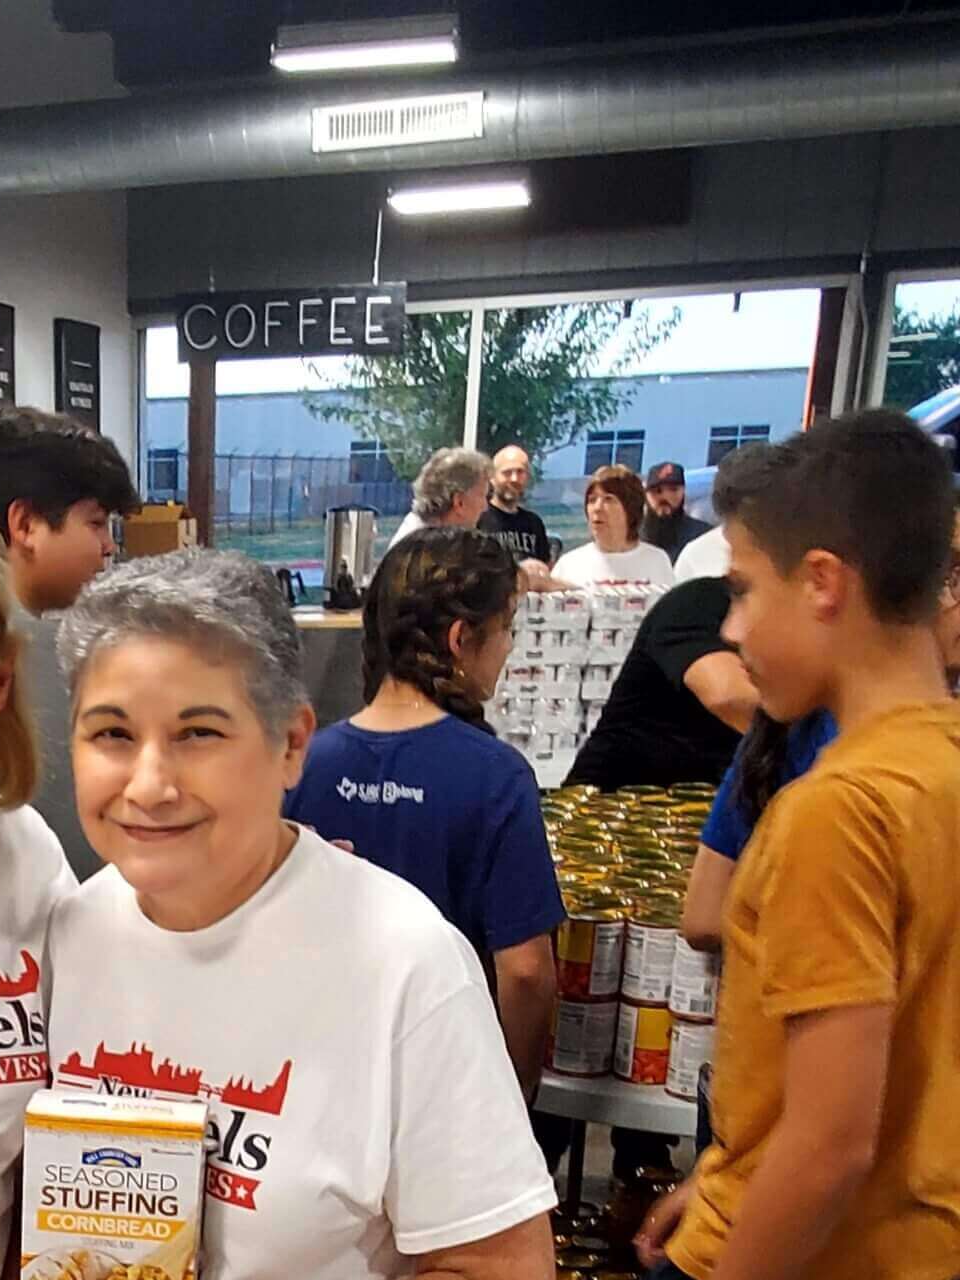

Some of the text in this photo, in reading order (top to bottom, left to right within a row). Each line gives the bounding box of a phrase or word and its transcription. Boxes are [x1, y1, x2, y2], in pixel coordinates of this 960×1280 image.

[183, 296, 391, 351] COFFEE
[97, 1076, 154, 1098] New
[44, 1164, 178, 1192] SEASONED
[41, 1186, 178, 1216] STUFFING
[47, 1213, 171, 1239] CORNBREAD
